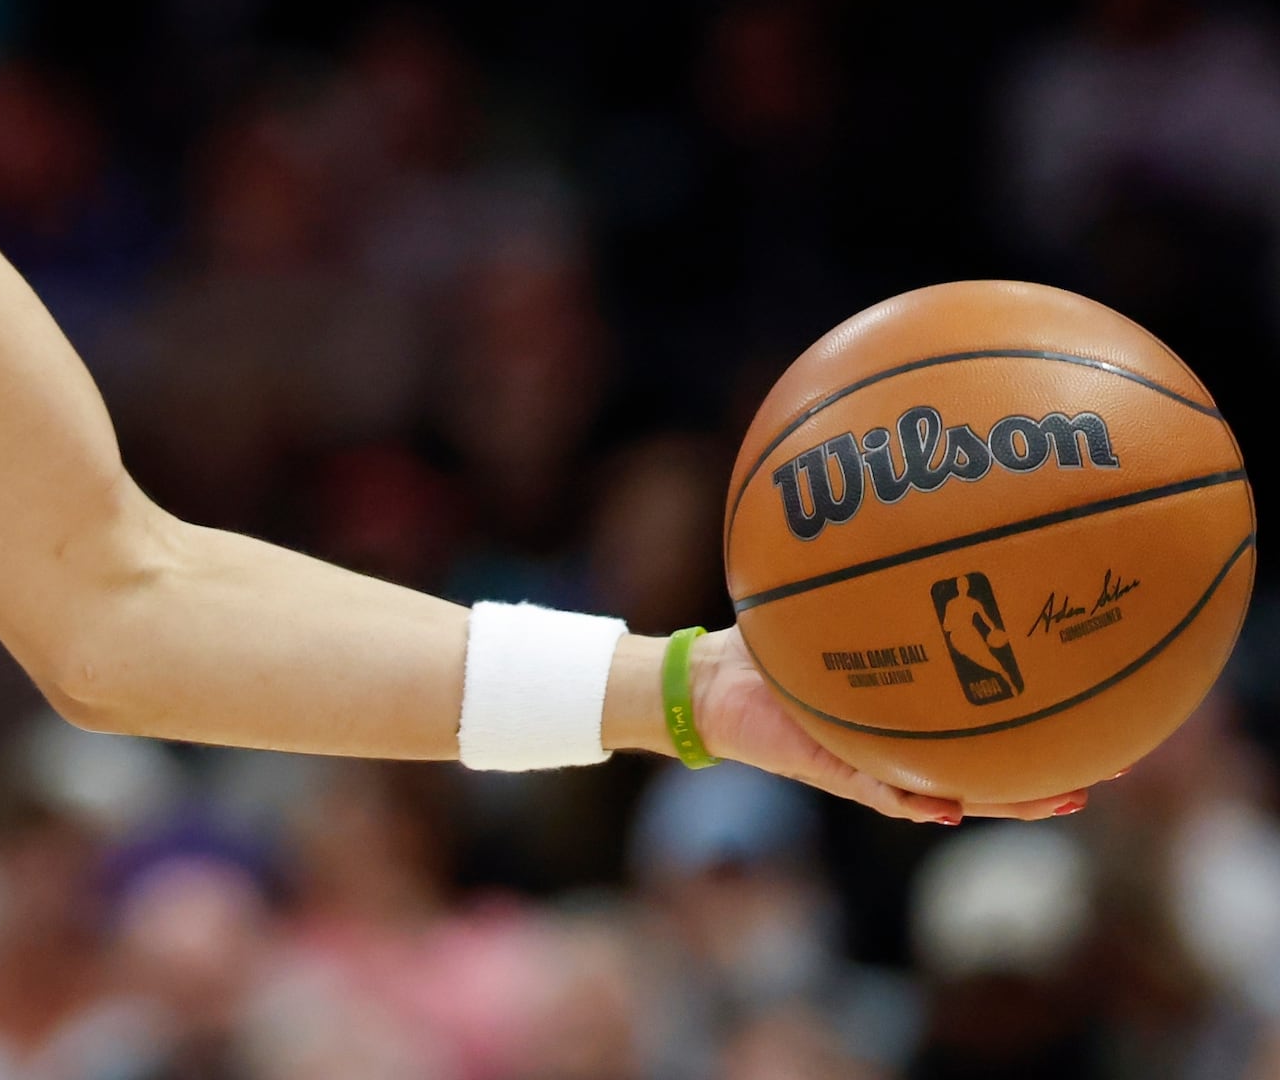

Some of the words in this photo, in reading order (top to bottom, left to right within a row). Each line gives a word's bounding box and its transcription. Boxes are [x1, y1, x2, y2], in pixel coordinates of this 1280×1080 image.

[772, 406, 1120, 541] Wilson
[822, 652, 868, 670] OFFICIAL
[866, 648, 900, 669] GAME
[898, 644, 928, 665] BALL
[969, 677, 1002, 699] NBA
